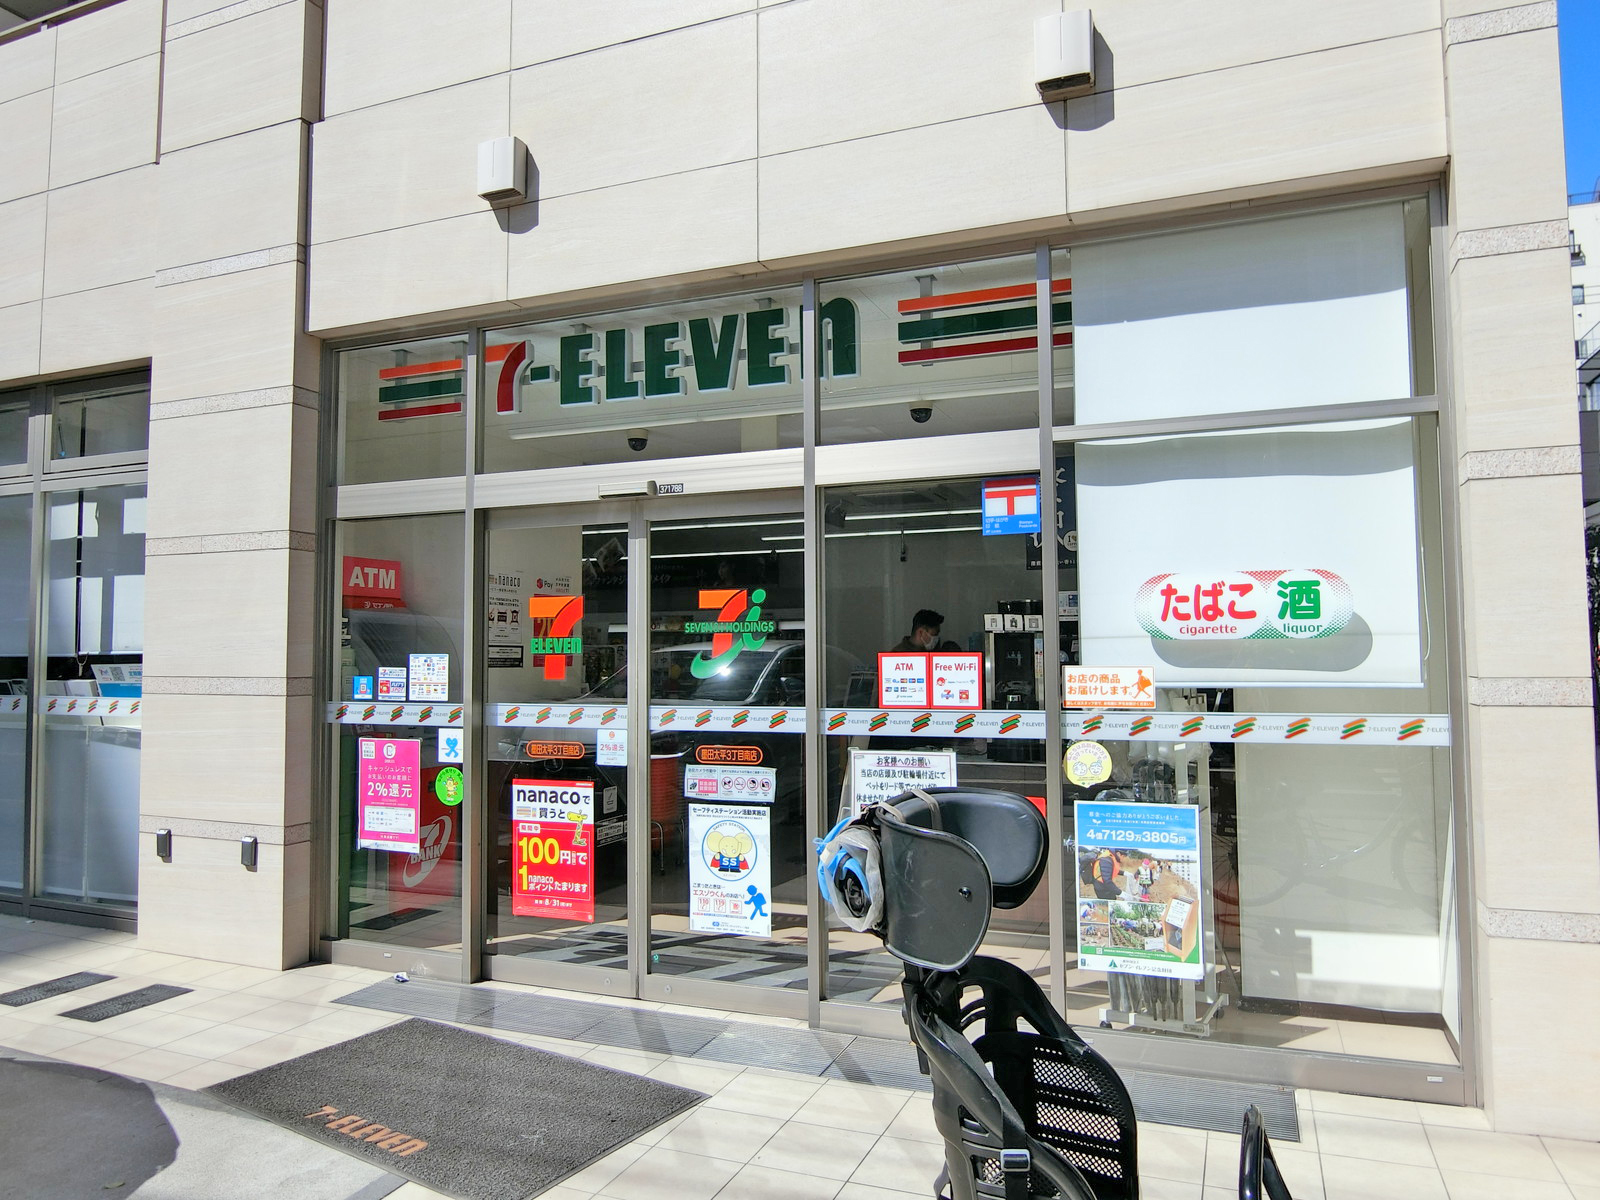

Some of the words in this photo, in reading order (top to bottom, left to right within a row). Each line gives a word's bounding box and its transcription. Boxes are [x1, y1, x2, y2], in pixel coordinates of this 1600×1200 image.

[348, 566, 396, 589] ATM
[1160, 581, 1257, 621] たばこ
[1276, 579, 1322, 620] 酒
[1179, 623, 1238, 638] cigarette
[1282, 621, 1323, 635] liquor
[894, 662, 914, 671] ATM
[934, 662, 953, 671] Free
[1067, 673, 1121, 684] お店の商品
[1067, 685, 1132, 696] お届けします。
[876, 756, 931, 766] お客様へのお願い
[368, 765, 413, 773] キャッシュレスで
[861, 769, 946, 780] 当店の店頭及び駐輪場付近にて
[367, 782, 413, 798] 2%還元
[539, 807, 566, 820] 買うと
[692, 807, 767, 816] セーフティステーション活動実施店
[713, 822, 728, 831] SAFETY
[1086, 829, 1188, 845] 4億7129万3805円
[722, 858, 737, 866] SS
[528, 875, 554, 883] nanaco
[528, 883, 555, 892] ポイント
[554, 881, 588, 893] たまります
[544, 899, 560, 907] 8/31
